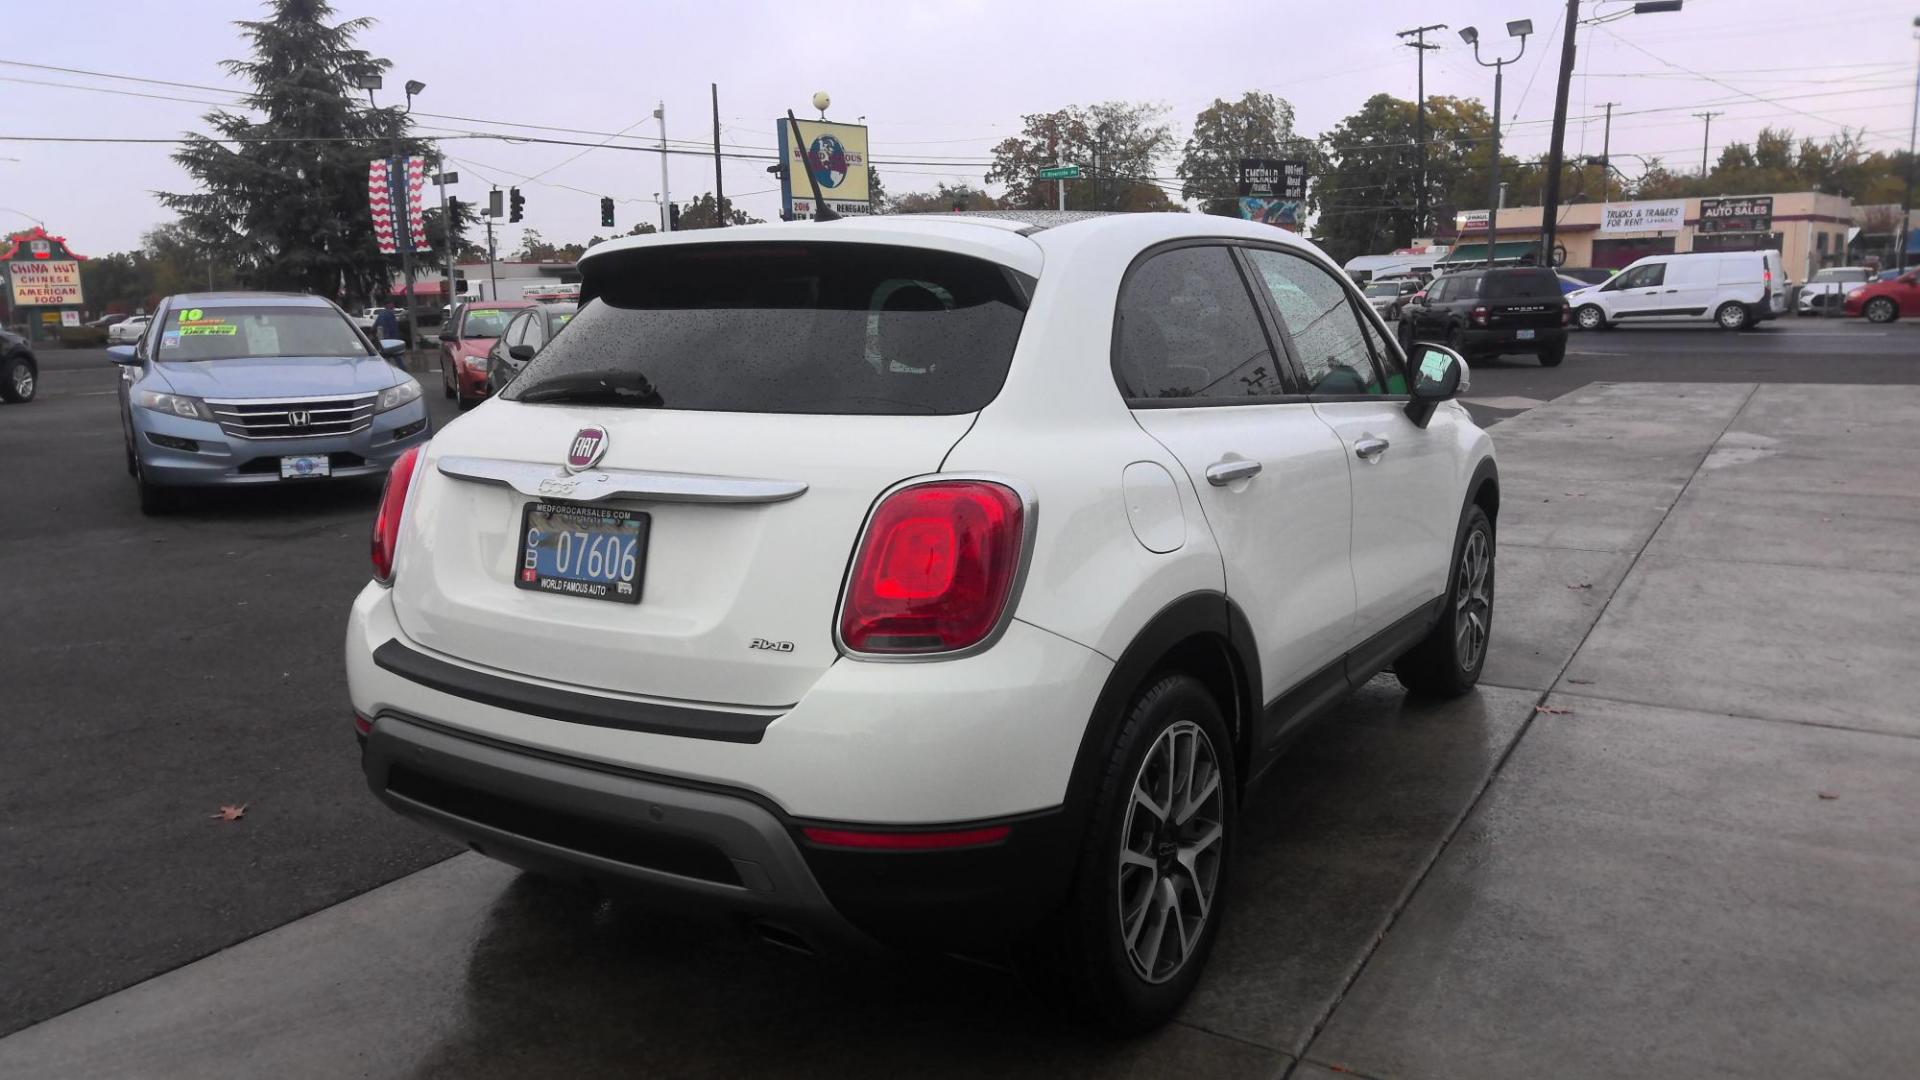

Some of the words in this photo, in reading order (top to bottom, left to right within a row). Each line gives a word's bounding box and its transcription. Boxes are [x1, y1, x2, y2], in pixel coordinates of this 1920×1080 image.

[1245, 168, 1278, 183] EMERALD
[836, 203, 869, 213] RENEGADE
[1607, 209, 1633, 219] TRUCKS
[1645, 207, 1680, 217] TRAILERS
[1705, 208, 1732, 217] AUTO
[1734, 205, 1767, 215] SALES
[1607, 219, 1621, 227] FOR
[1624, 218, 1643, 226] RENT
[10, 263, 48, 274] CHINA
[53, 263, 76, 273] HUT
[20, 275, 70, 284] CHINESE
[19, 288, 76, 296] AMERICAN
[35, 296, 64, 304] FOOD
[571, 437, 599, 457] FIAT
[556, 530, 637, 582] 07606
[541, 578, 562, 589] WORLD
[563, 581, 588, 593] FAMOUS
[589, 584, 606, 595] AUTO
[749, 638, 795, 652] AWD
